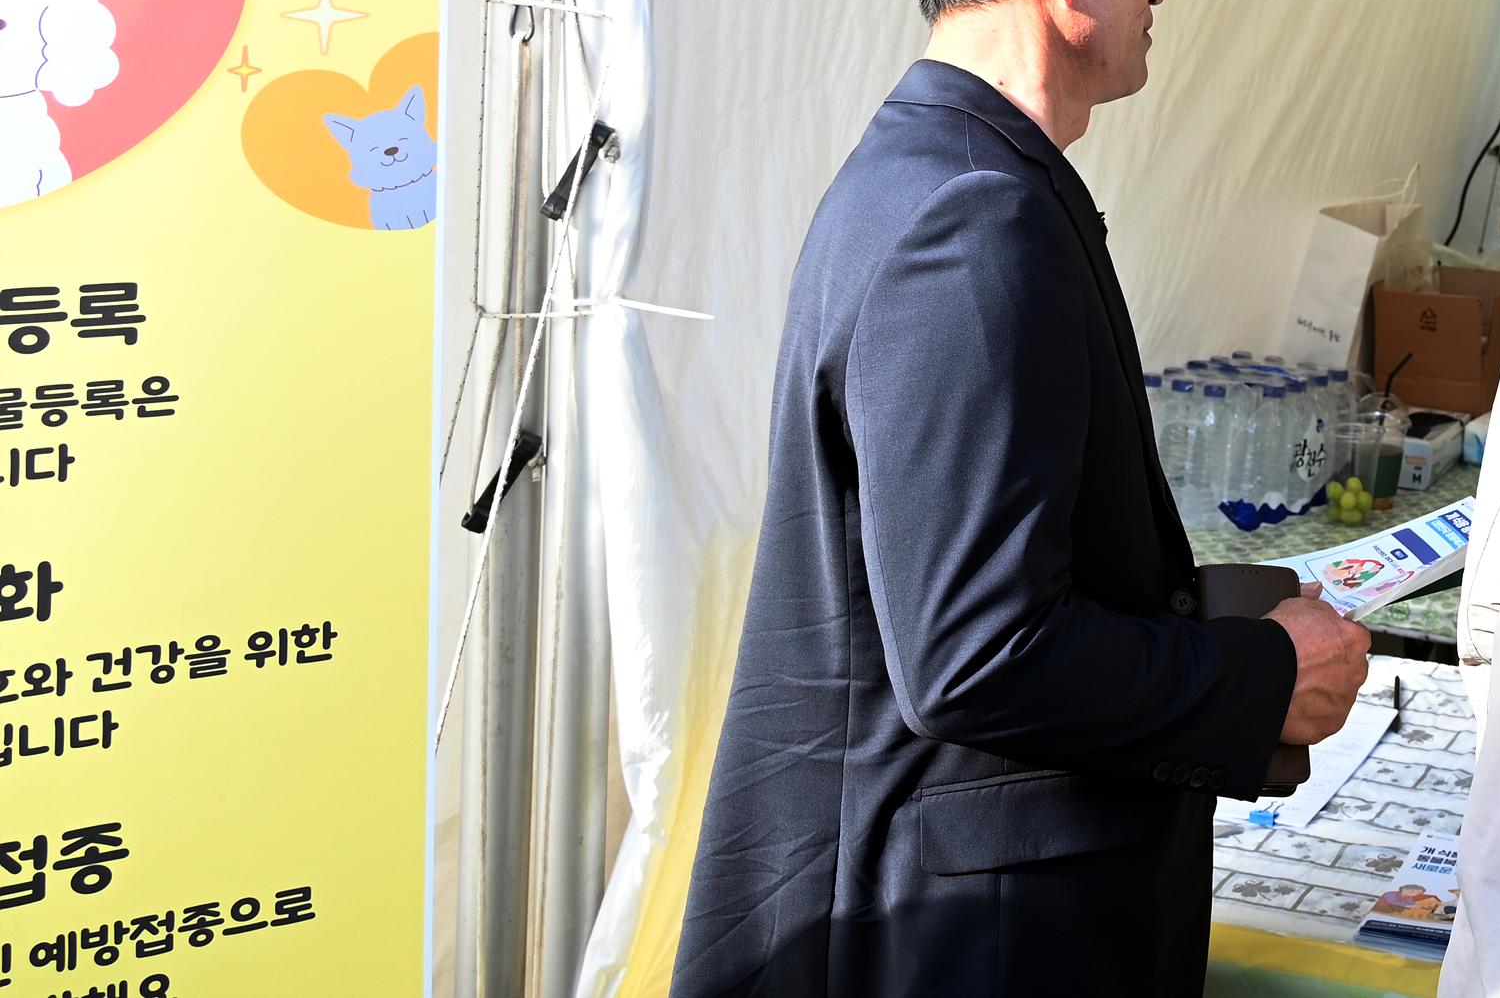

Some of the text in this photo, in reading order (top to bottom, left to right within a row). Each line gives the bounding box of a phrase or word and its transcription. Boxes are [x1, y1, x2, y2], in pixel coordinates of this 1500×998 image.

[0, 281, 147, 355] 등록
[1412, 473, 1422, 485] M
[0, 560, 64, 622] 화
[86, 634, 232, 694] 건강을
[243, 620, 338, 669] 위한
[0, 821, 131, 910] 접종
[29, 885, 317, 973] 예방접종으로
